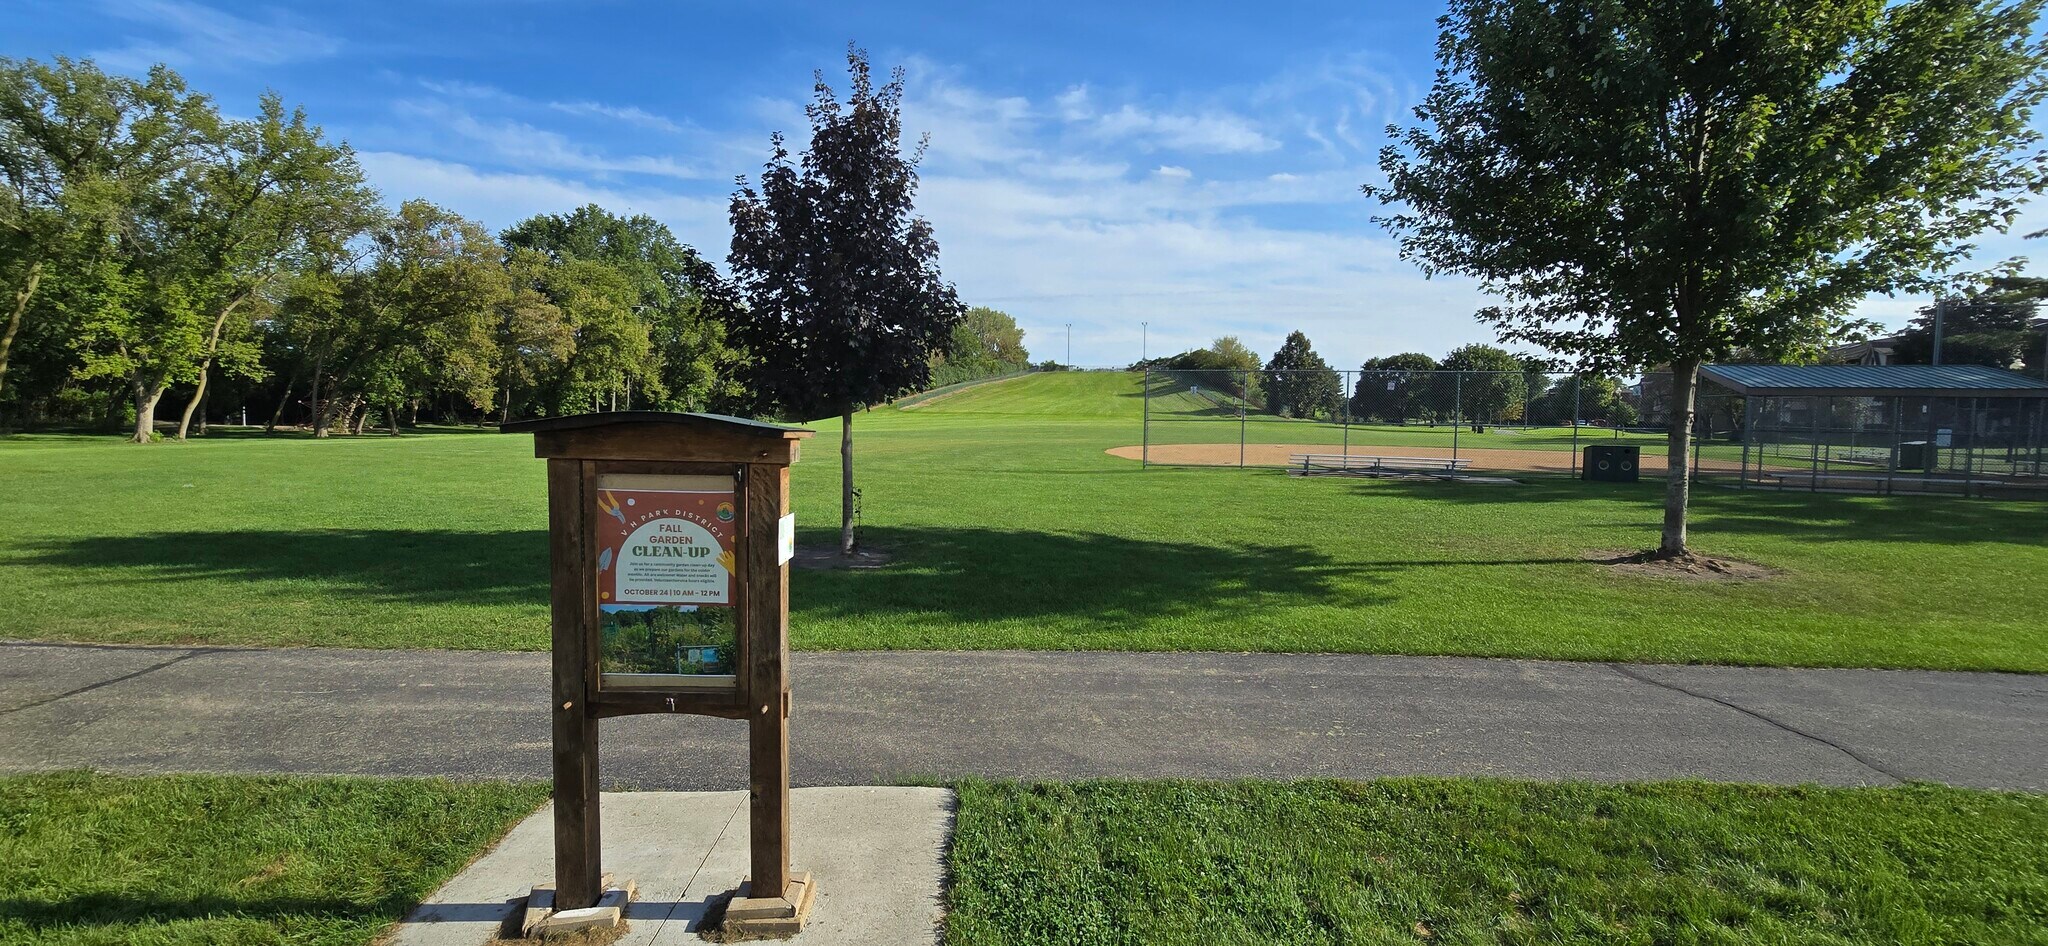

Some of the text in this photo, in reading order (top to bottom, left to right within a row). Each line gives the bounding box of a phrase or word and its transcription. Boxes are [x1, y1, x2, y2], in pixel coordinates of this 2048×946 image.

[640, 509, 669, 521] PARK
[675, 509, 724, 538] DISTRICT
[659, 524, 683, 533] FALL
[649, 535, 693, 545] GARDEN
[632, 545, 711, 558] CLEAN-UP
